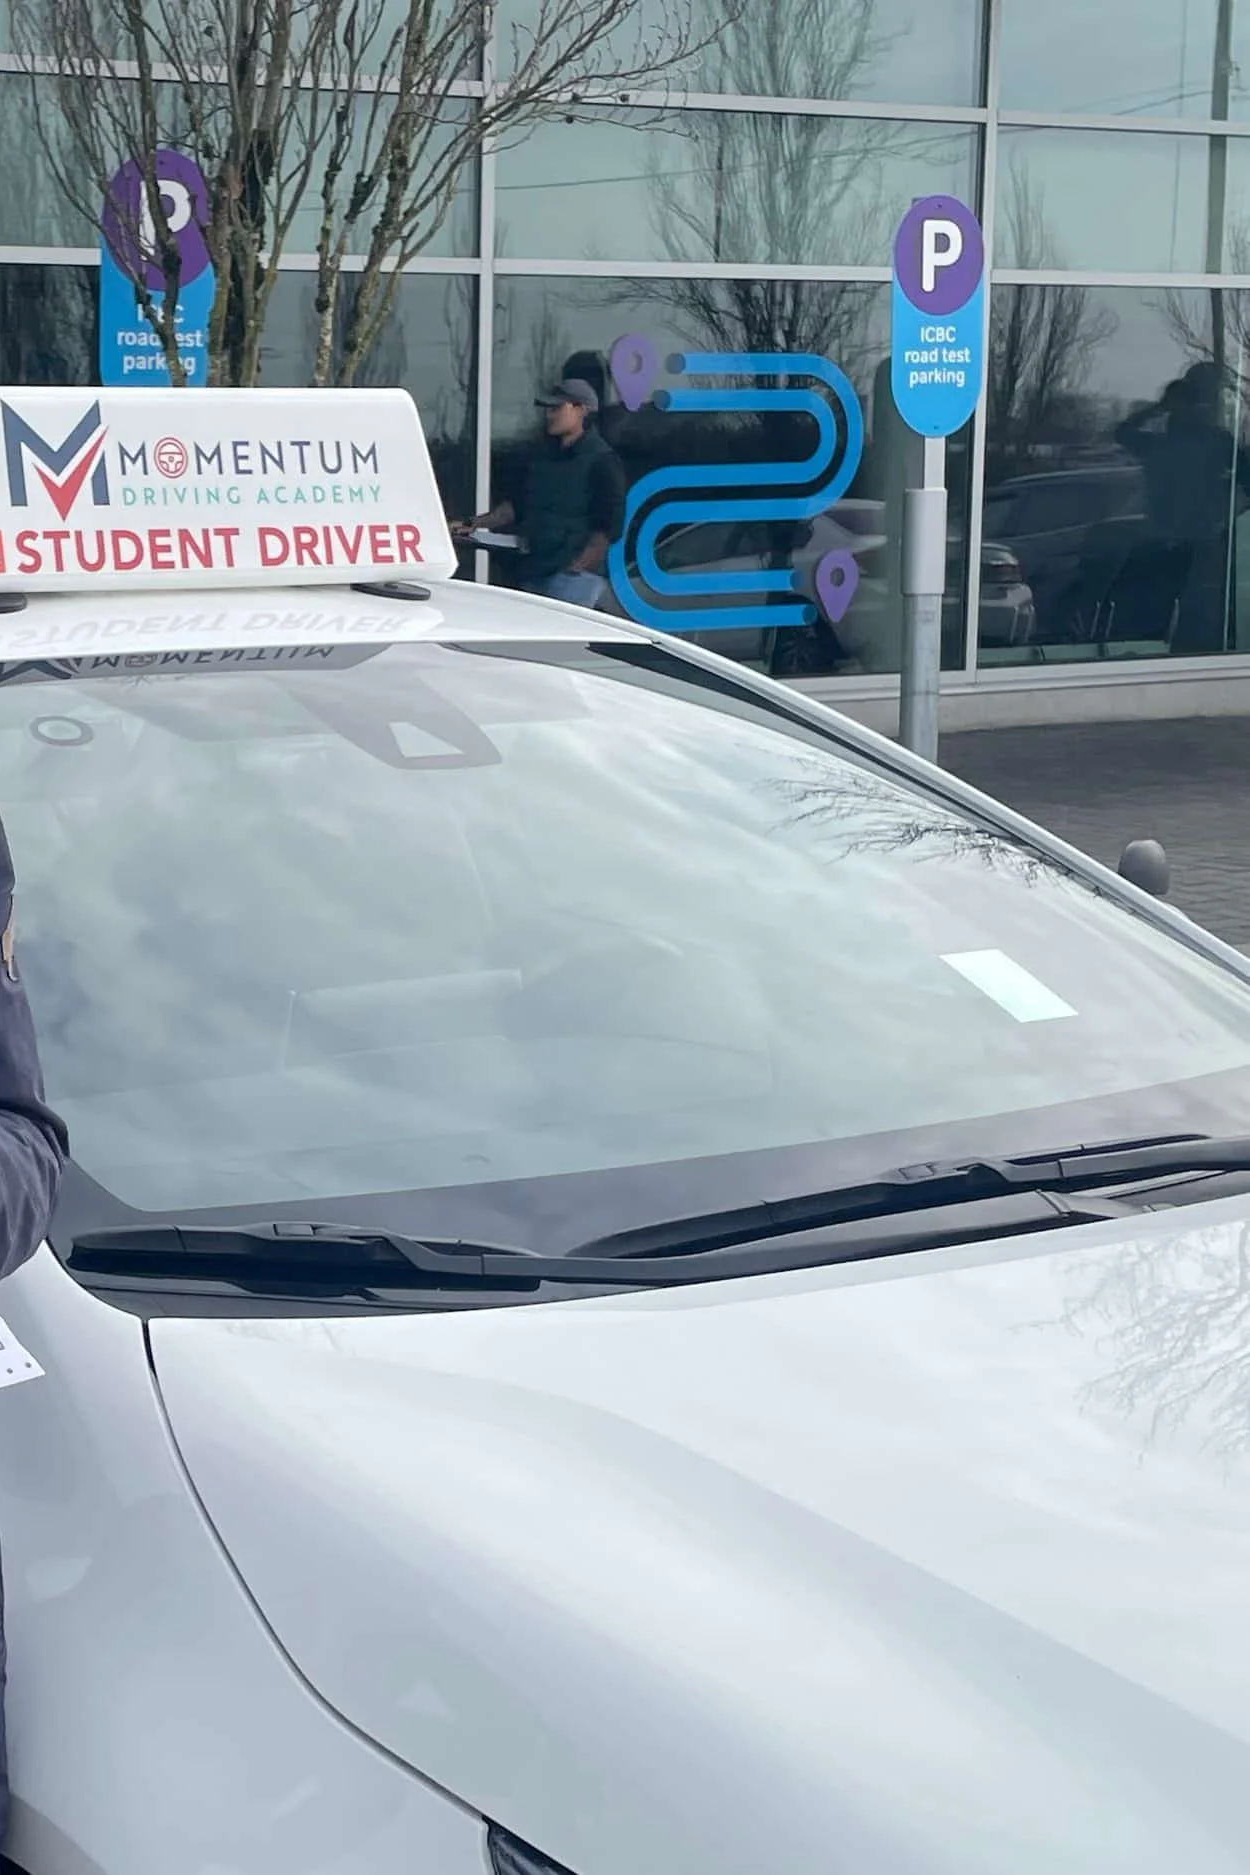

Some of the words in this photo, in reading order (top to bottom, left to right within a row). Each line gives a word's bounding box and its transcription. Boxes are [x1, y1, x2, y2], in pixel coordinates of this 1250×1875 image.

[921, 219, 963, 292] P
[173, 330, 204, 347] est
[920, 327, 956, 343] ICBC
[123, 352, 196, 376] parkg
[905, 348, 938, 363] road
[942, 348, 971, 363] test
[909, 368, 965, 388] parking
[123, 485, 241, 506] DRIVING
[256, 483, 382, 505] ACADEMY
[14, 527, 239, 573] STUDENT
[257, 524, 425, 568] DRIVER
